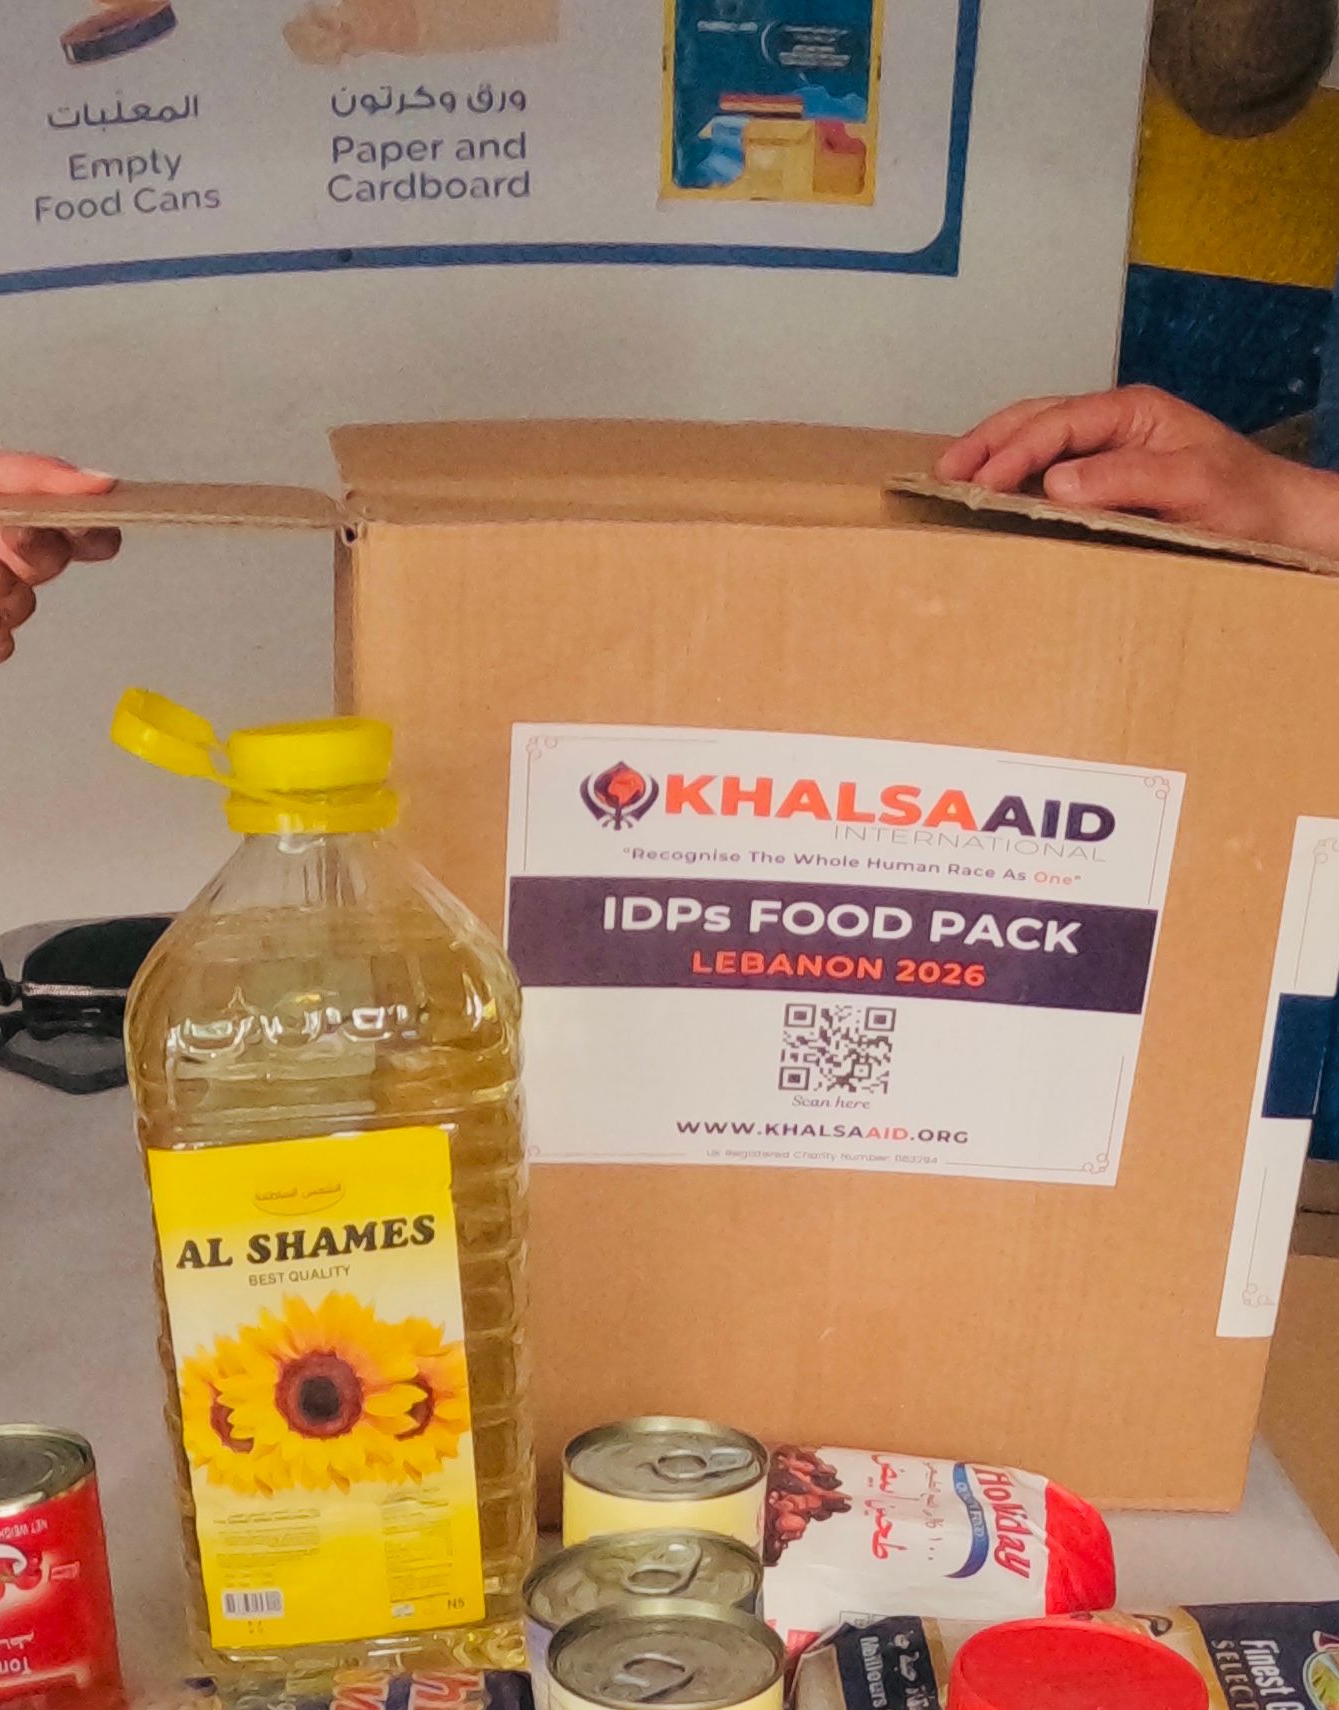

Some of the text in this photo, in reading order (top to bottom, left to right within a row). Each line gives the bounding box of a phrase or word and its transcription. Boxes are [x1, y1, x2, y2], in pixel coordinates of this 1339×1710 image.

[47, 93, 199, 132] المعلبات
[331, 83, 527, 118] ورق وكرتون
[68, 148, 181, 182] Empty
[332, 131, 527, 170] Paper and
[34, 187, 221, 223] Food Cans
[327, 170, 531, 203] Cardboard
[665, 773, 1117, 844] KHALSAAID
[833, 824, 1107, 863] INTERNATIONAL
[749, 850, 1028, 882] The Whole Human Race As
[603, 897, 1082, 955] IDPs FOOD PACK
[691, 950, 987, 988] LEBANON 2026
[791, 1096, 871, 1111] Scan here
[676, 1120, 970, 1145] WWW.KHALSAAID.ORG
[175, 1213, 437, 1270] AL SHAMES
[248, 1264, 352, 1288] BEST QUALITY
[1238, 1639, 1297, 1697] Finest
